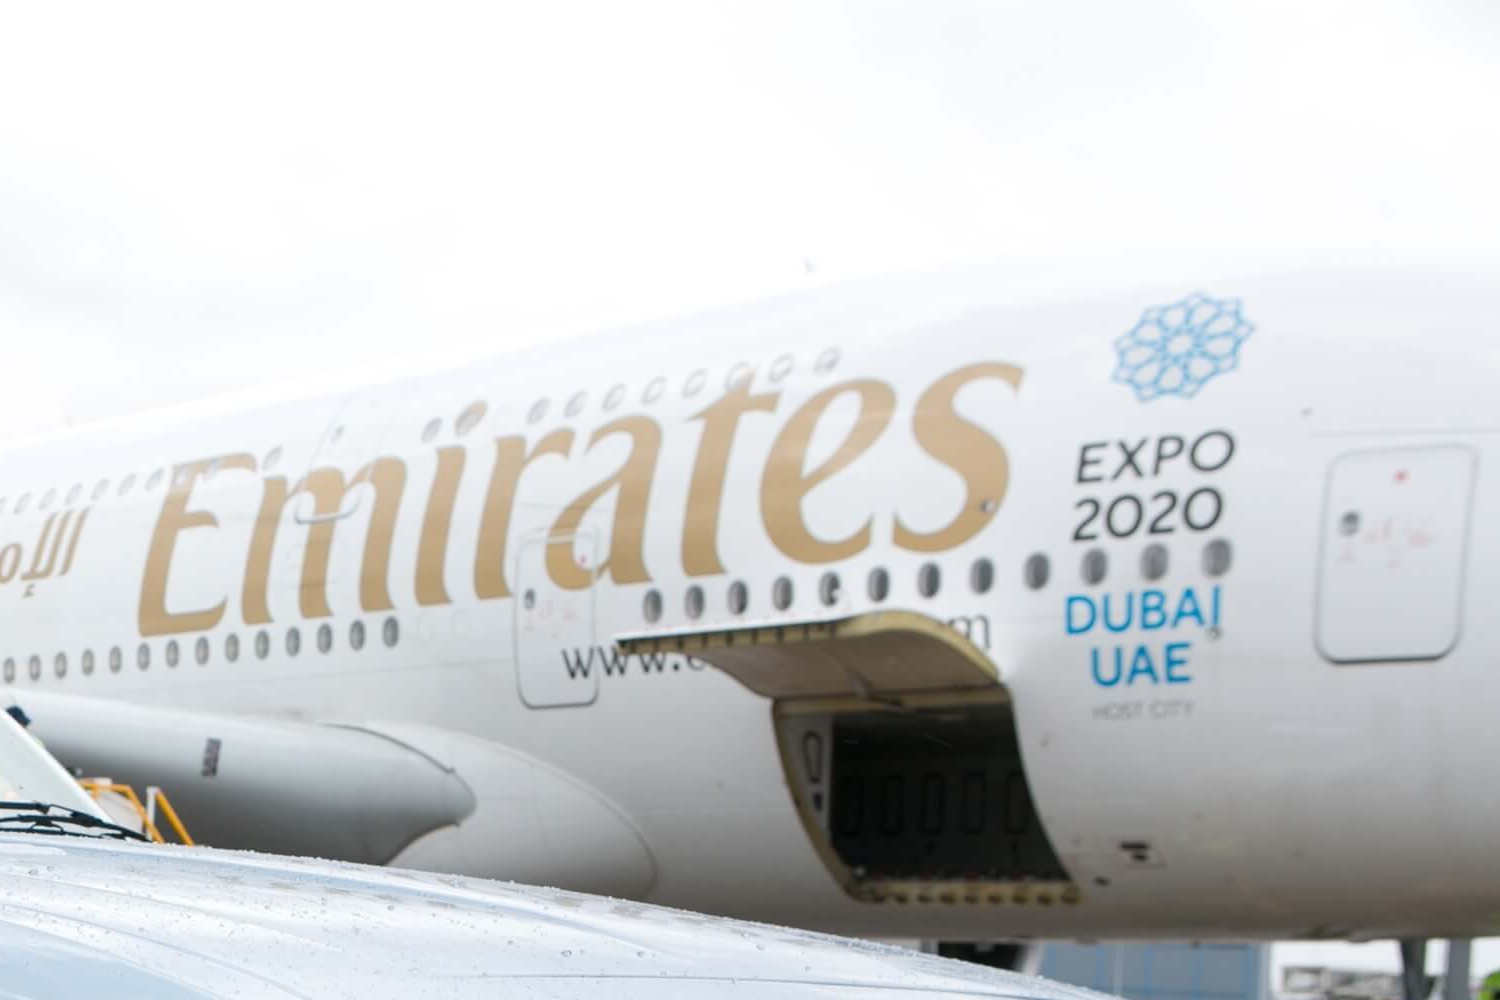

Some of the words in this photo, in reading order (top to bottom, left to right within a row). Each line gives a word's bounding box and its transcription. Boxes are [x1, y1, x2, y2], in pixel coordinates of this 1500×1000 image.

[1075, 429, 1237, 484] EXPO
[137, 361, 1024, 638] Emirates
[1071, 486, 1224, 543] 2020
[1064, 584, 1223, 636] DUBAI
[1089, 642, 1194, 688] UAE
